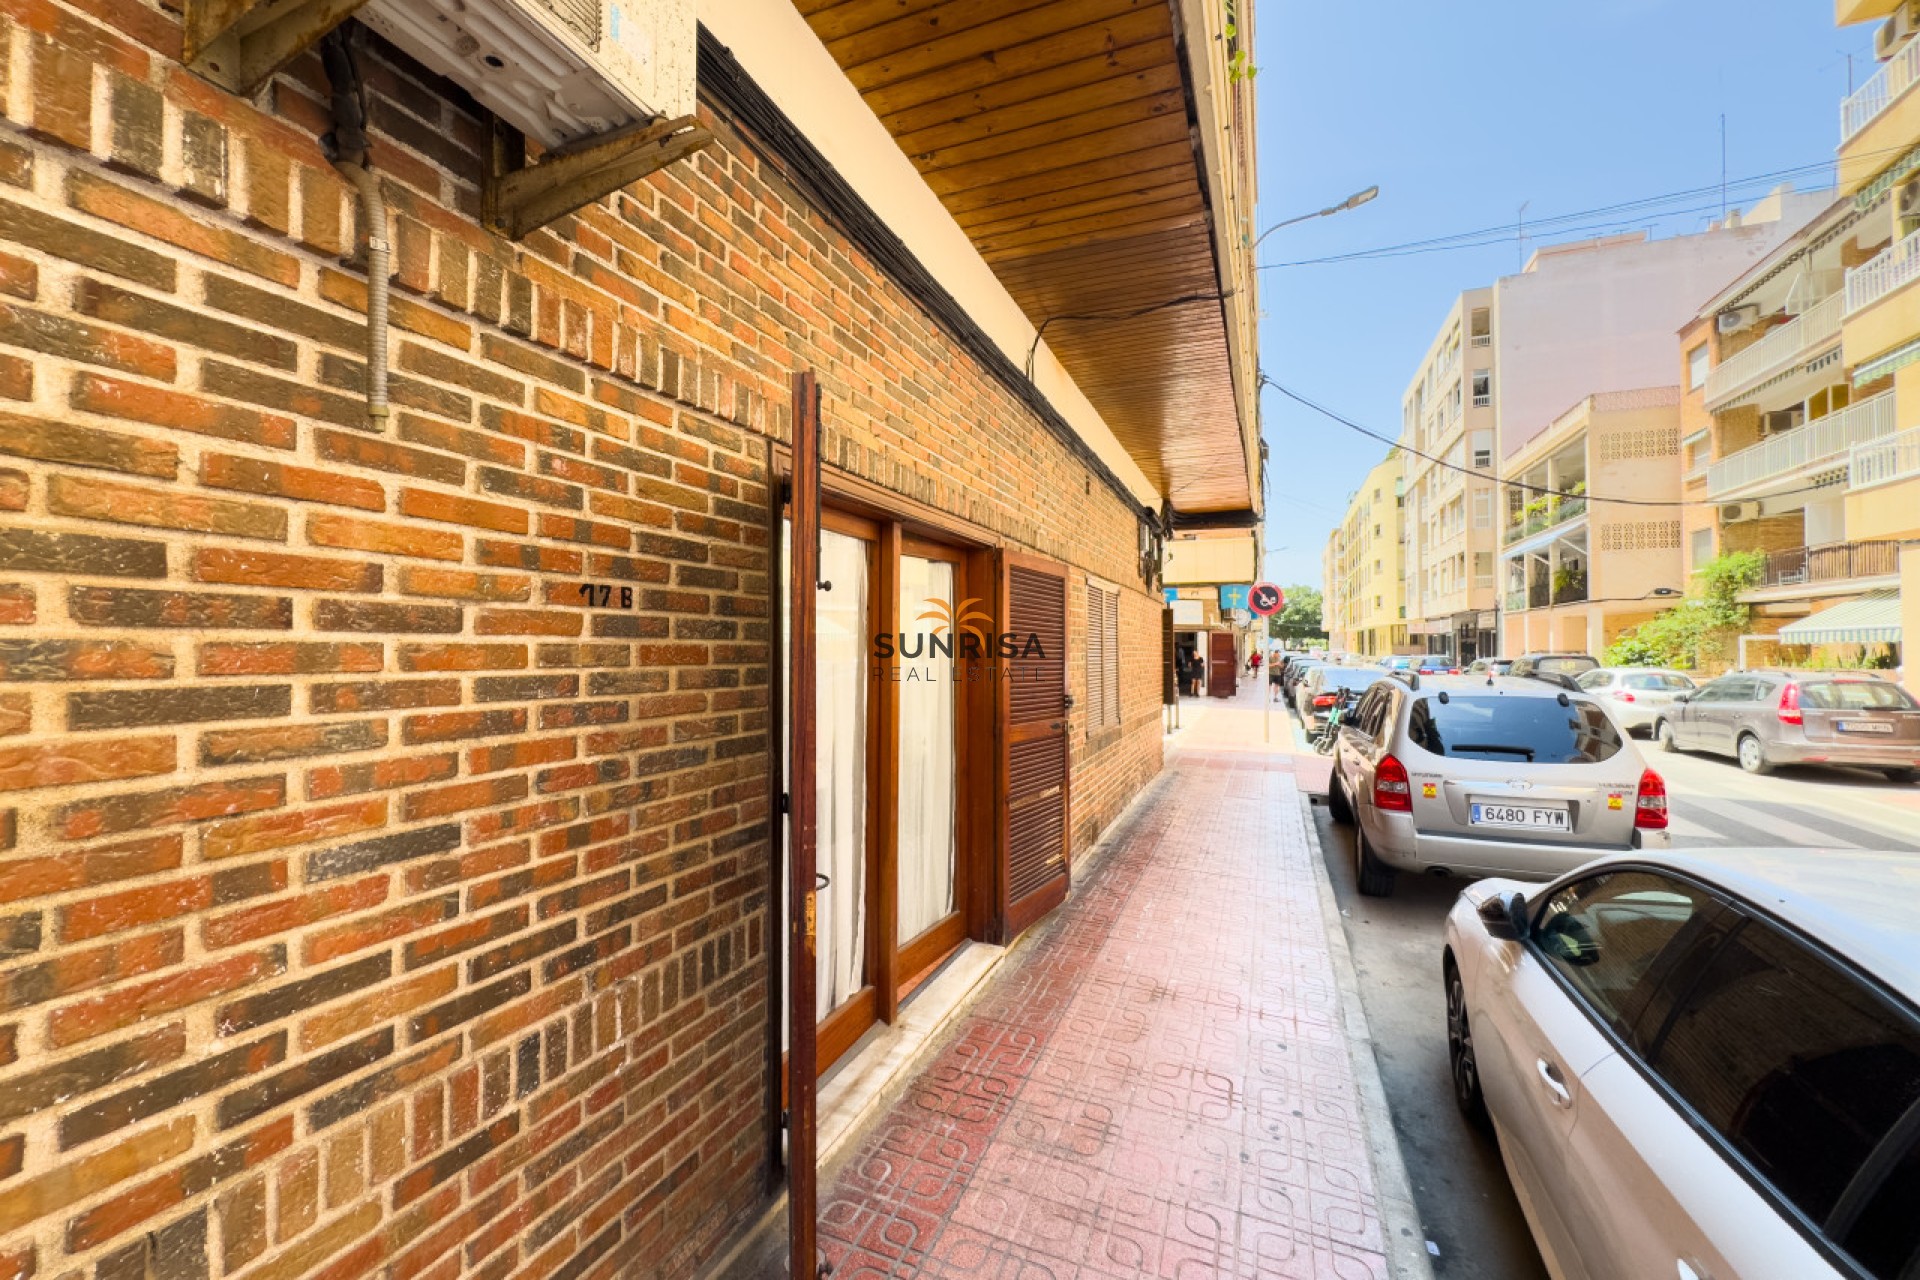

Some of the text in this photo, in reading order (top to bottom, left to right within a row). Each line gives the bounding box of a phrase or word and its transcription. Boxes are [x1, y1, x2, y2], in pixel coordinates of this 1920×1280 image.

[579, 584, 633, 608] 17 B
[1485, 807, 1564, 825] 6480 FYW
